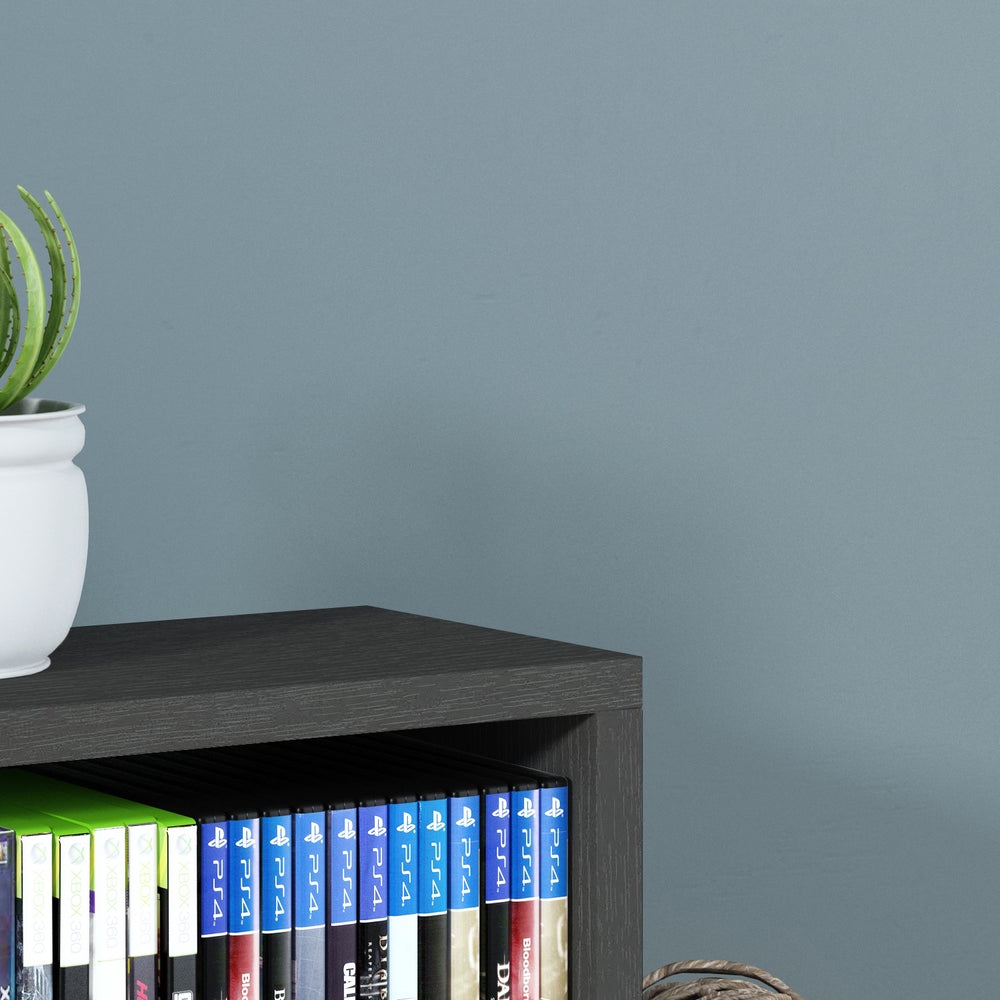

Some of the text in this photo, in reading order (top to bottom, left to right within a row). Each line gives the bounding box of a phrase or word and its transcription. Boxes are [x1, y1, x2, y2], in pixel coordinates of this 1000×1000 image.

[309, 854, 319, 915] PS4
[343, 850, 352, 910] PS4
[373, 848, 383, 907] PS4
[402, 844, 411, 903] PS4
[431, 842, 441, 901] PS4
[462, 838, 471, 897] PS4
[497, 828, 507, 887] PS4
[522, 828, 532, 886] PS4
[550, 828, 560, 885] PS4
[32, 870, 45, 954] XBOX 360
[70, 869, 82, 954] XBOX 360
[105, 864, 119, 949] XBOX 360
[139, 861, 152, 944] XBOX 360
[178, 861, 191, 944] XBOX 360
[213, 859, 224, 922] PS4
[240, 859, 251, 920] PS4
[275, 857, 285, 918] PS4
